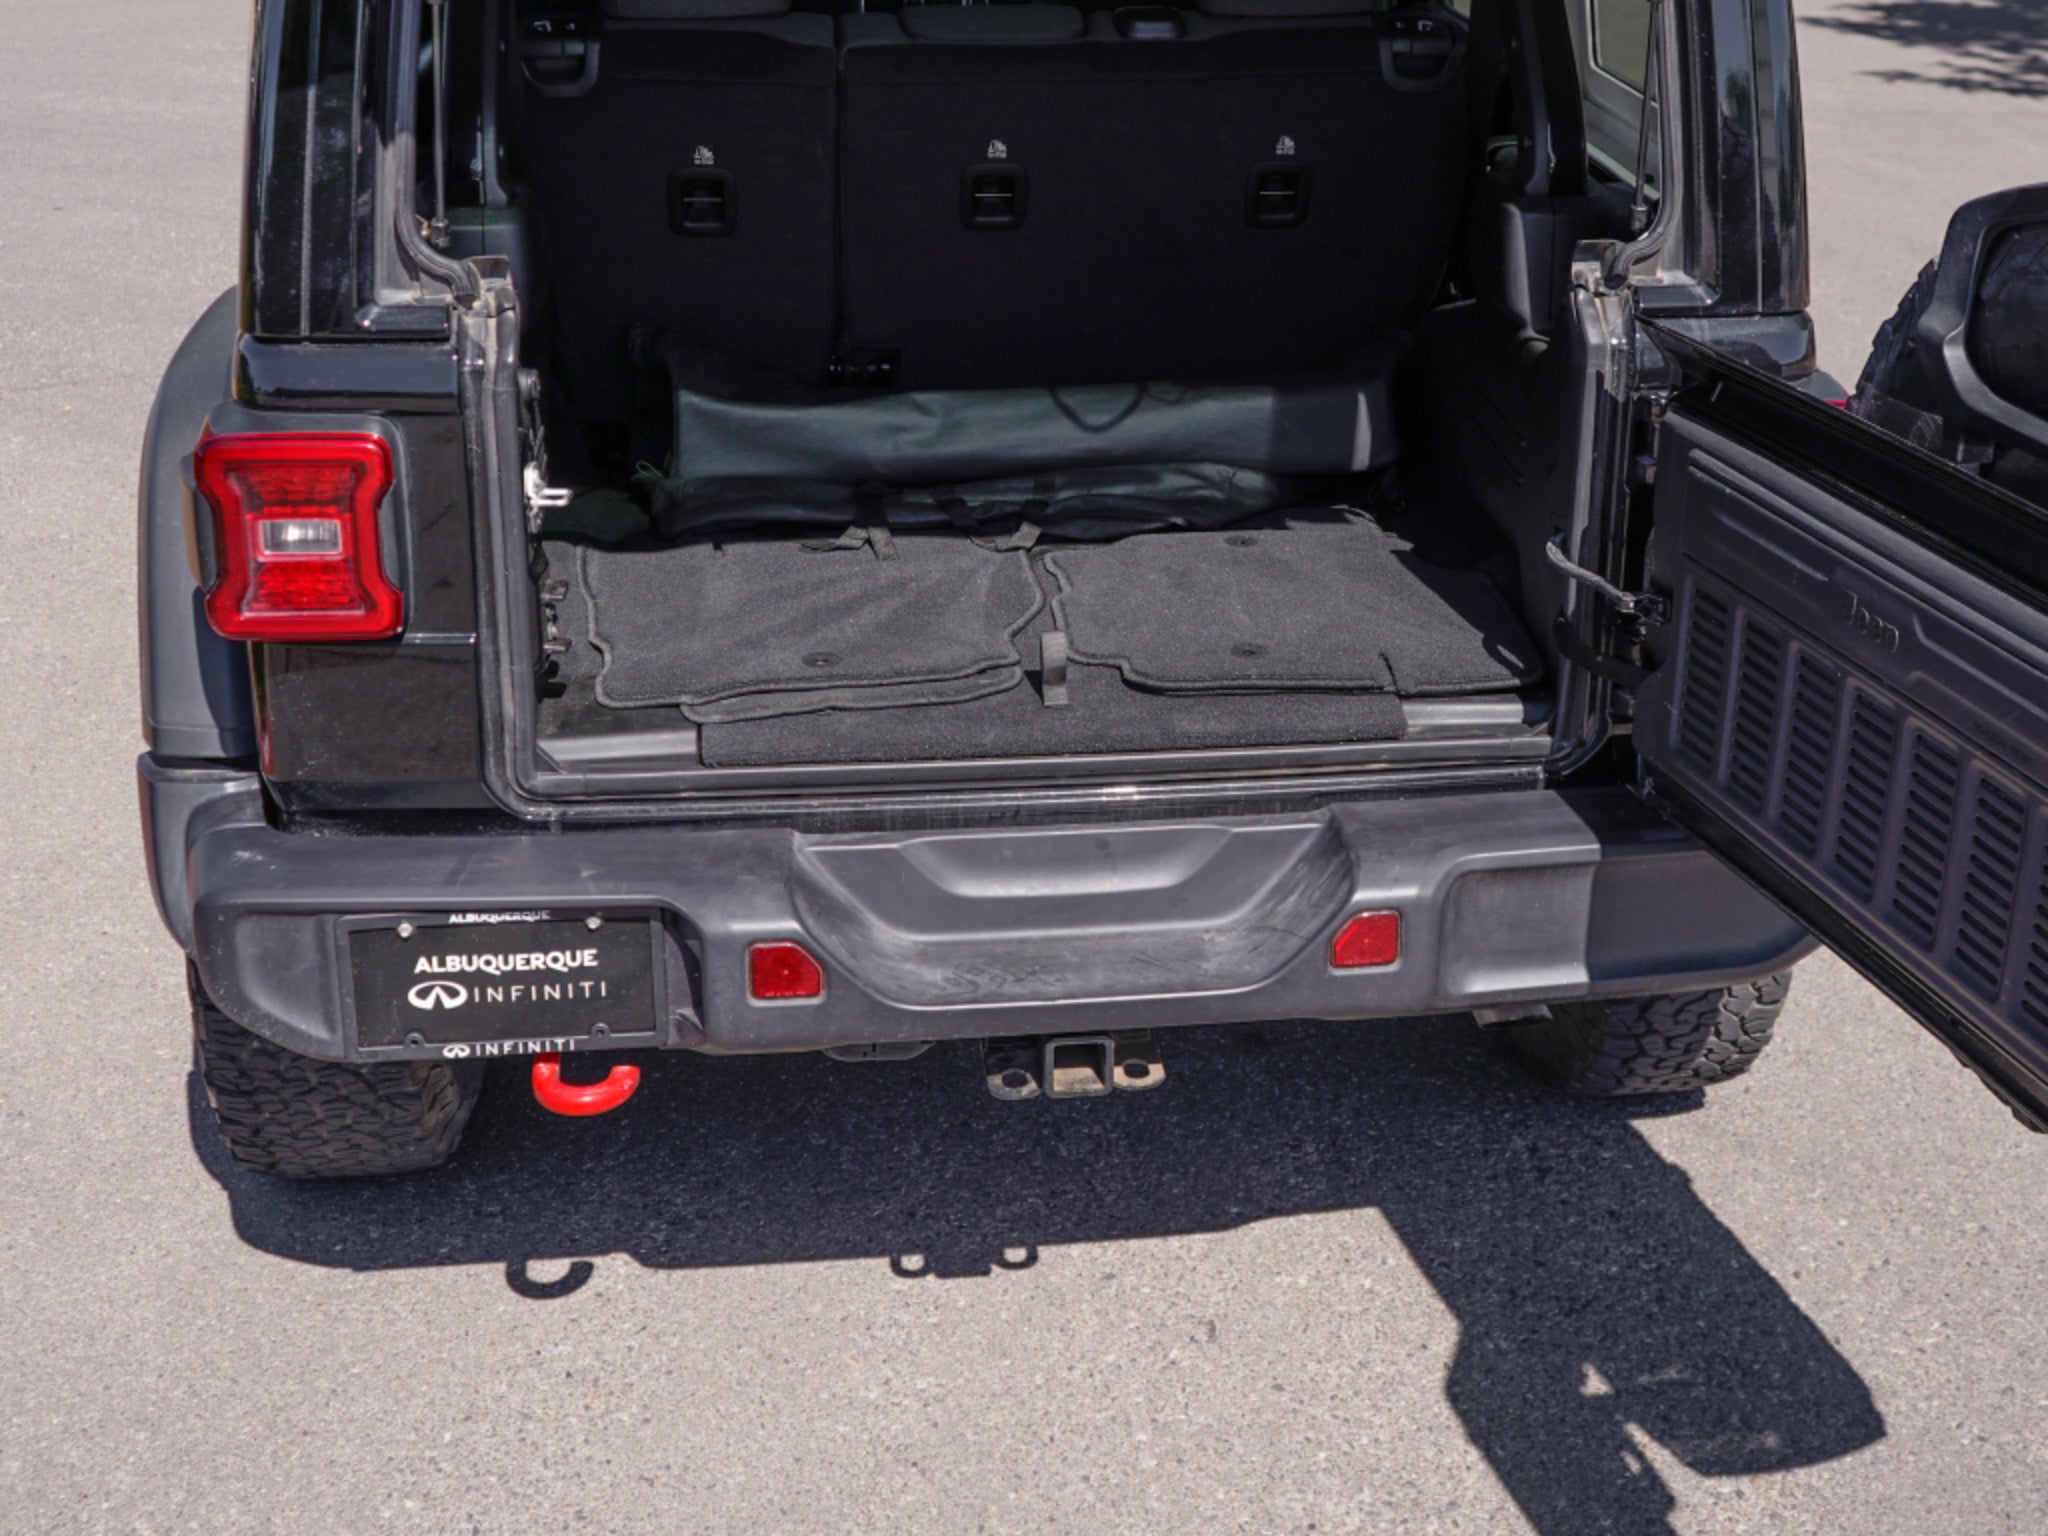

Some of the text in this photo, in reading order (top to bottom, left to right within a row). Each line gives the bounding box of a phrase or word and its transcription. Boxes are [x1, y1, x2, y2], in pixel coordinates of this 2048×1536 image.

[1842, 589, 1899, 653] Jeep
[448, 910, 551, 925] ALBUQUERQUE
[414, 948, 599, 976] ALBUQUERQUE
[474, 981, 607, 1003] INFINITI
[475, 1038, 575, 1056] INFINITI
